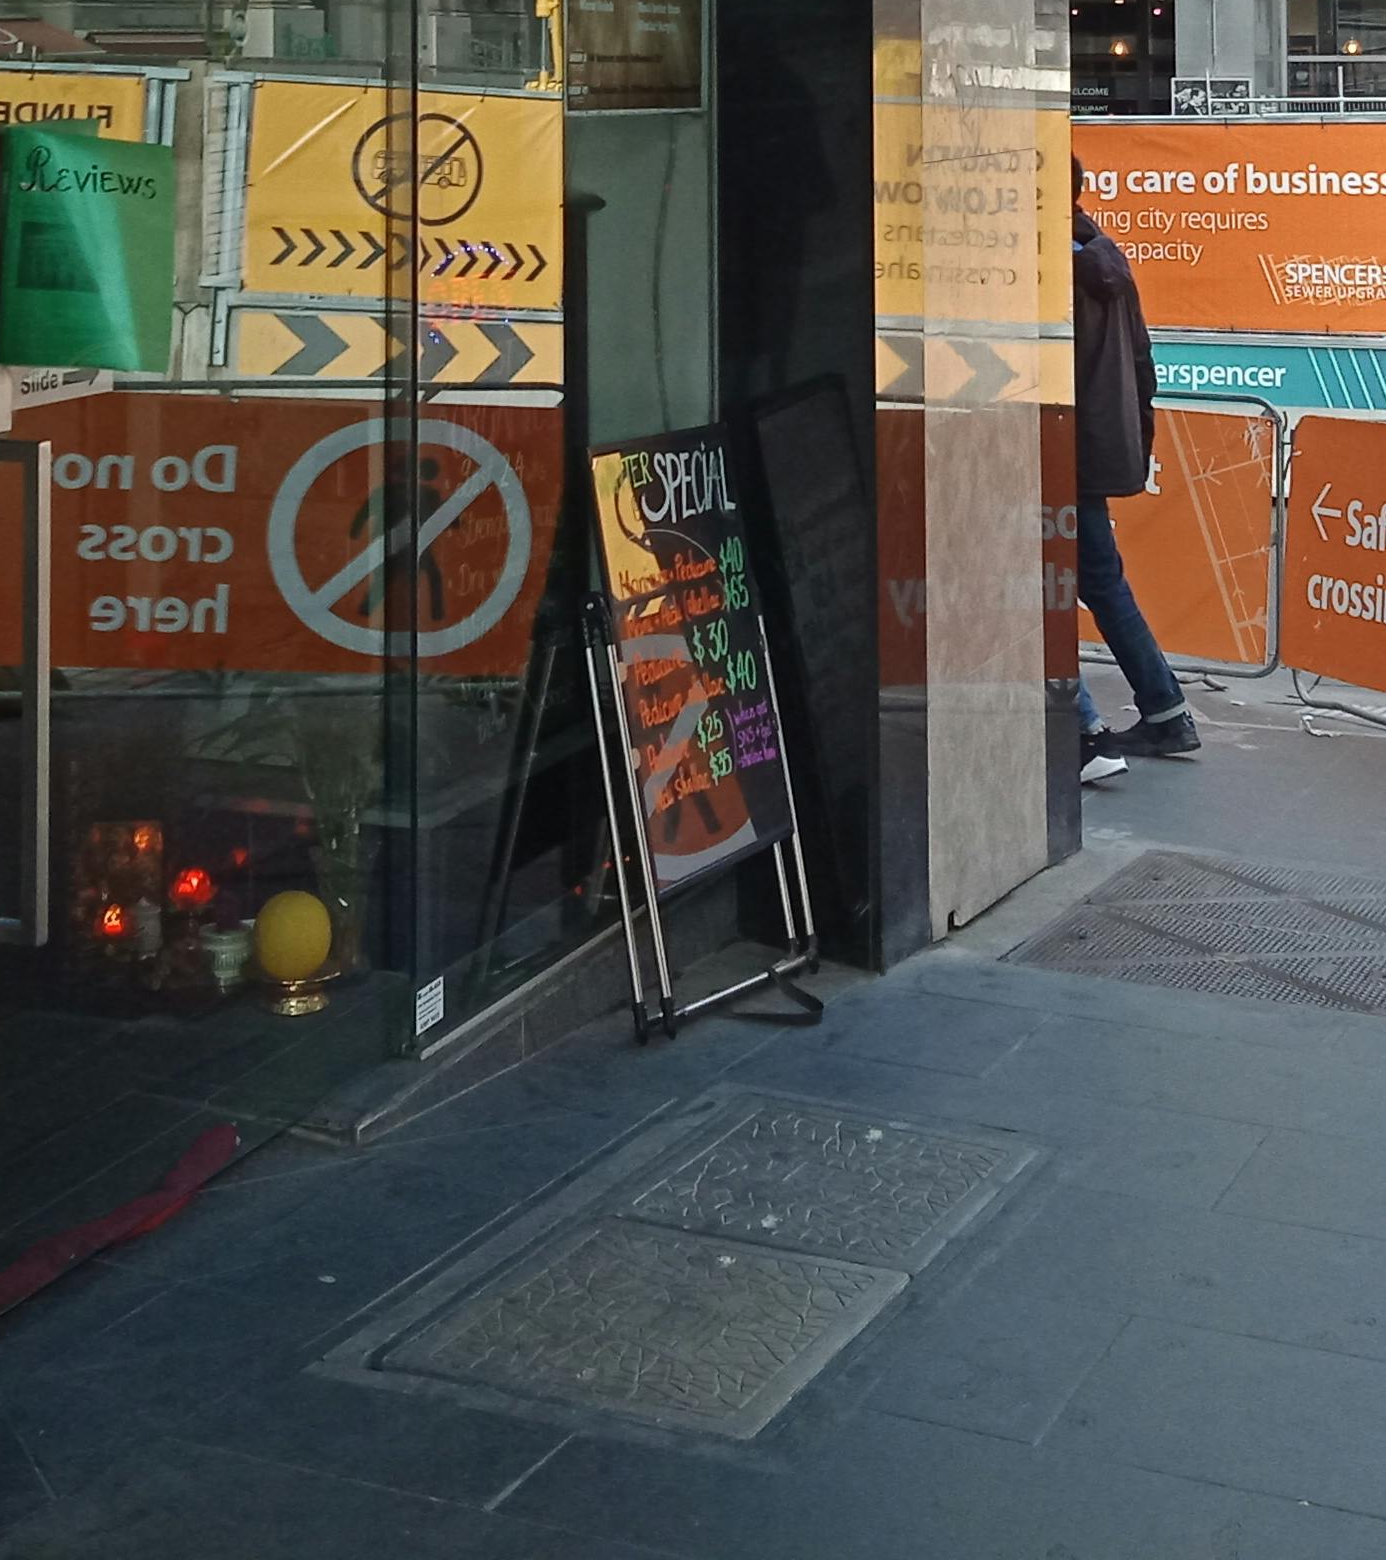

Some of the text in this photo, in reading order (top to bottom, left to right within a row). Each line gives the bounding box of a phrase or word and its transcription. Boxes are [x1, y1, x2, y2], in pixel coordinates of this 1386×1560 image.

[1125, 169, 1197, 194] care
[1203, 162, 1240, 194] of
[1136, 206, 1176, 234] city
[1180, 208, 1269, 235] requires
[1285, 262, 1383, 286] SPENCER
[1285, 286, 1333, 299] SEWER
[20, 370, 59, 395] Slide
